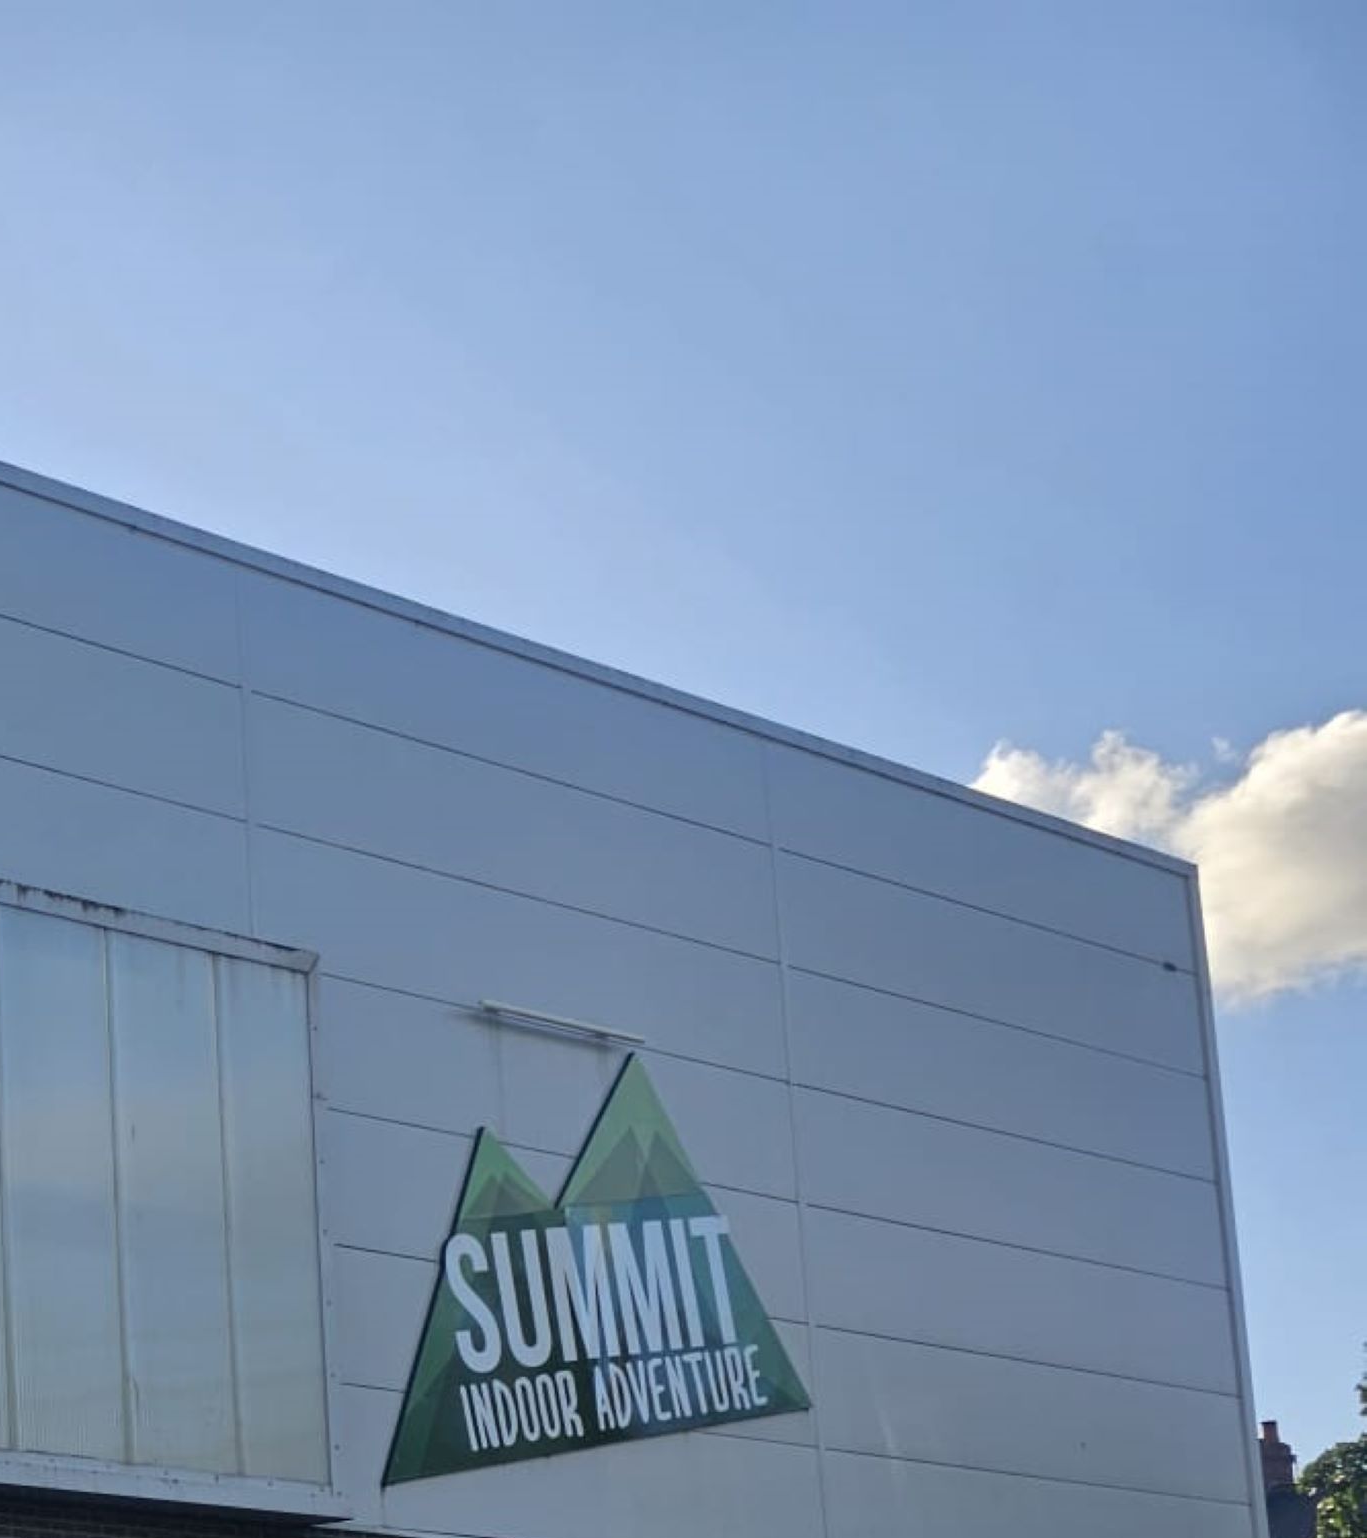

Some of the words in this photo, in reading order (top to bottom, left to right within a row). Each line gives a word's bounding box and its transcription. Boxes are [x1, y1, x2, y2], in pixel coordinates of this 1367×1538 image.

[445, 1215, 739, 1373] SUMMIT
[460, 1371, 584, 1451] INDOOR
[594, 1345, 768, 1431] ADVENTURE
